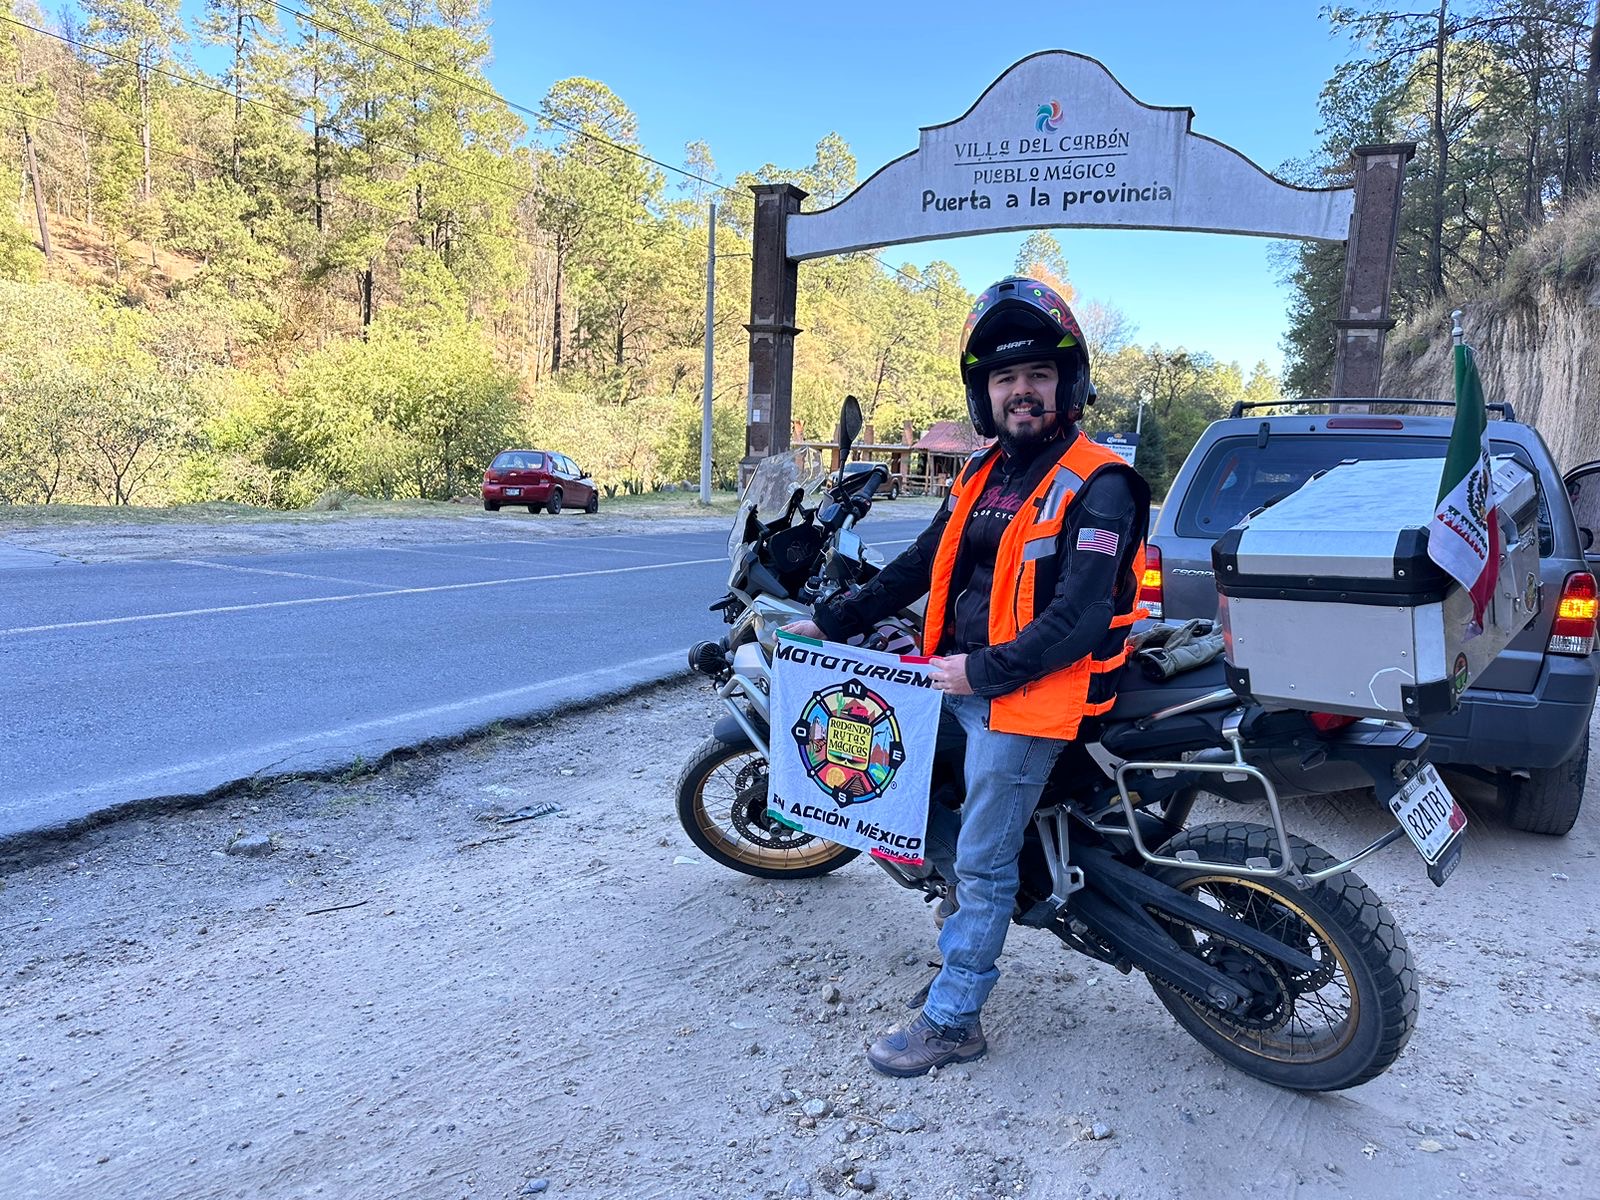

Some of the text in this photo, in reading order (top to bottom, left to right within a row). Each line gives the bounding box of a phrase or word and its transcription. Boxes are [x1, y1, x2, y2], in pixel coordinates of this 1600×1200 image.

[922, 181, 1172, 212] Puerta a la provincia
[996, 339, 1035, 352] SHAFT
[1171, 568, 1215, 577] ESCAP
[775, 642, 932, 689] MOTOTURISM
[848, 684, 862, 696] N
[795, 727, 807, 737] O
[892, 750, 902, 760] E
[837, 792, 848, 803] S
[1407, 784, 1452, 841] 82ATB1
[772, 793, 922, 850] EN ACCIÓN MÉXICO
